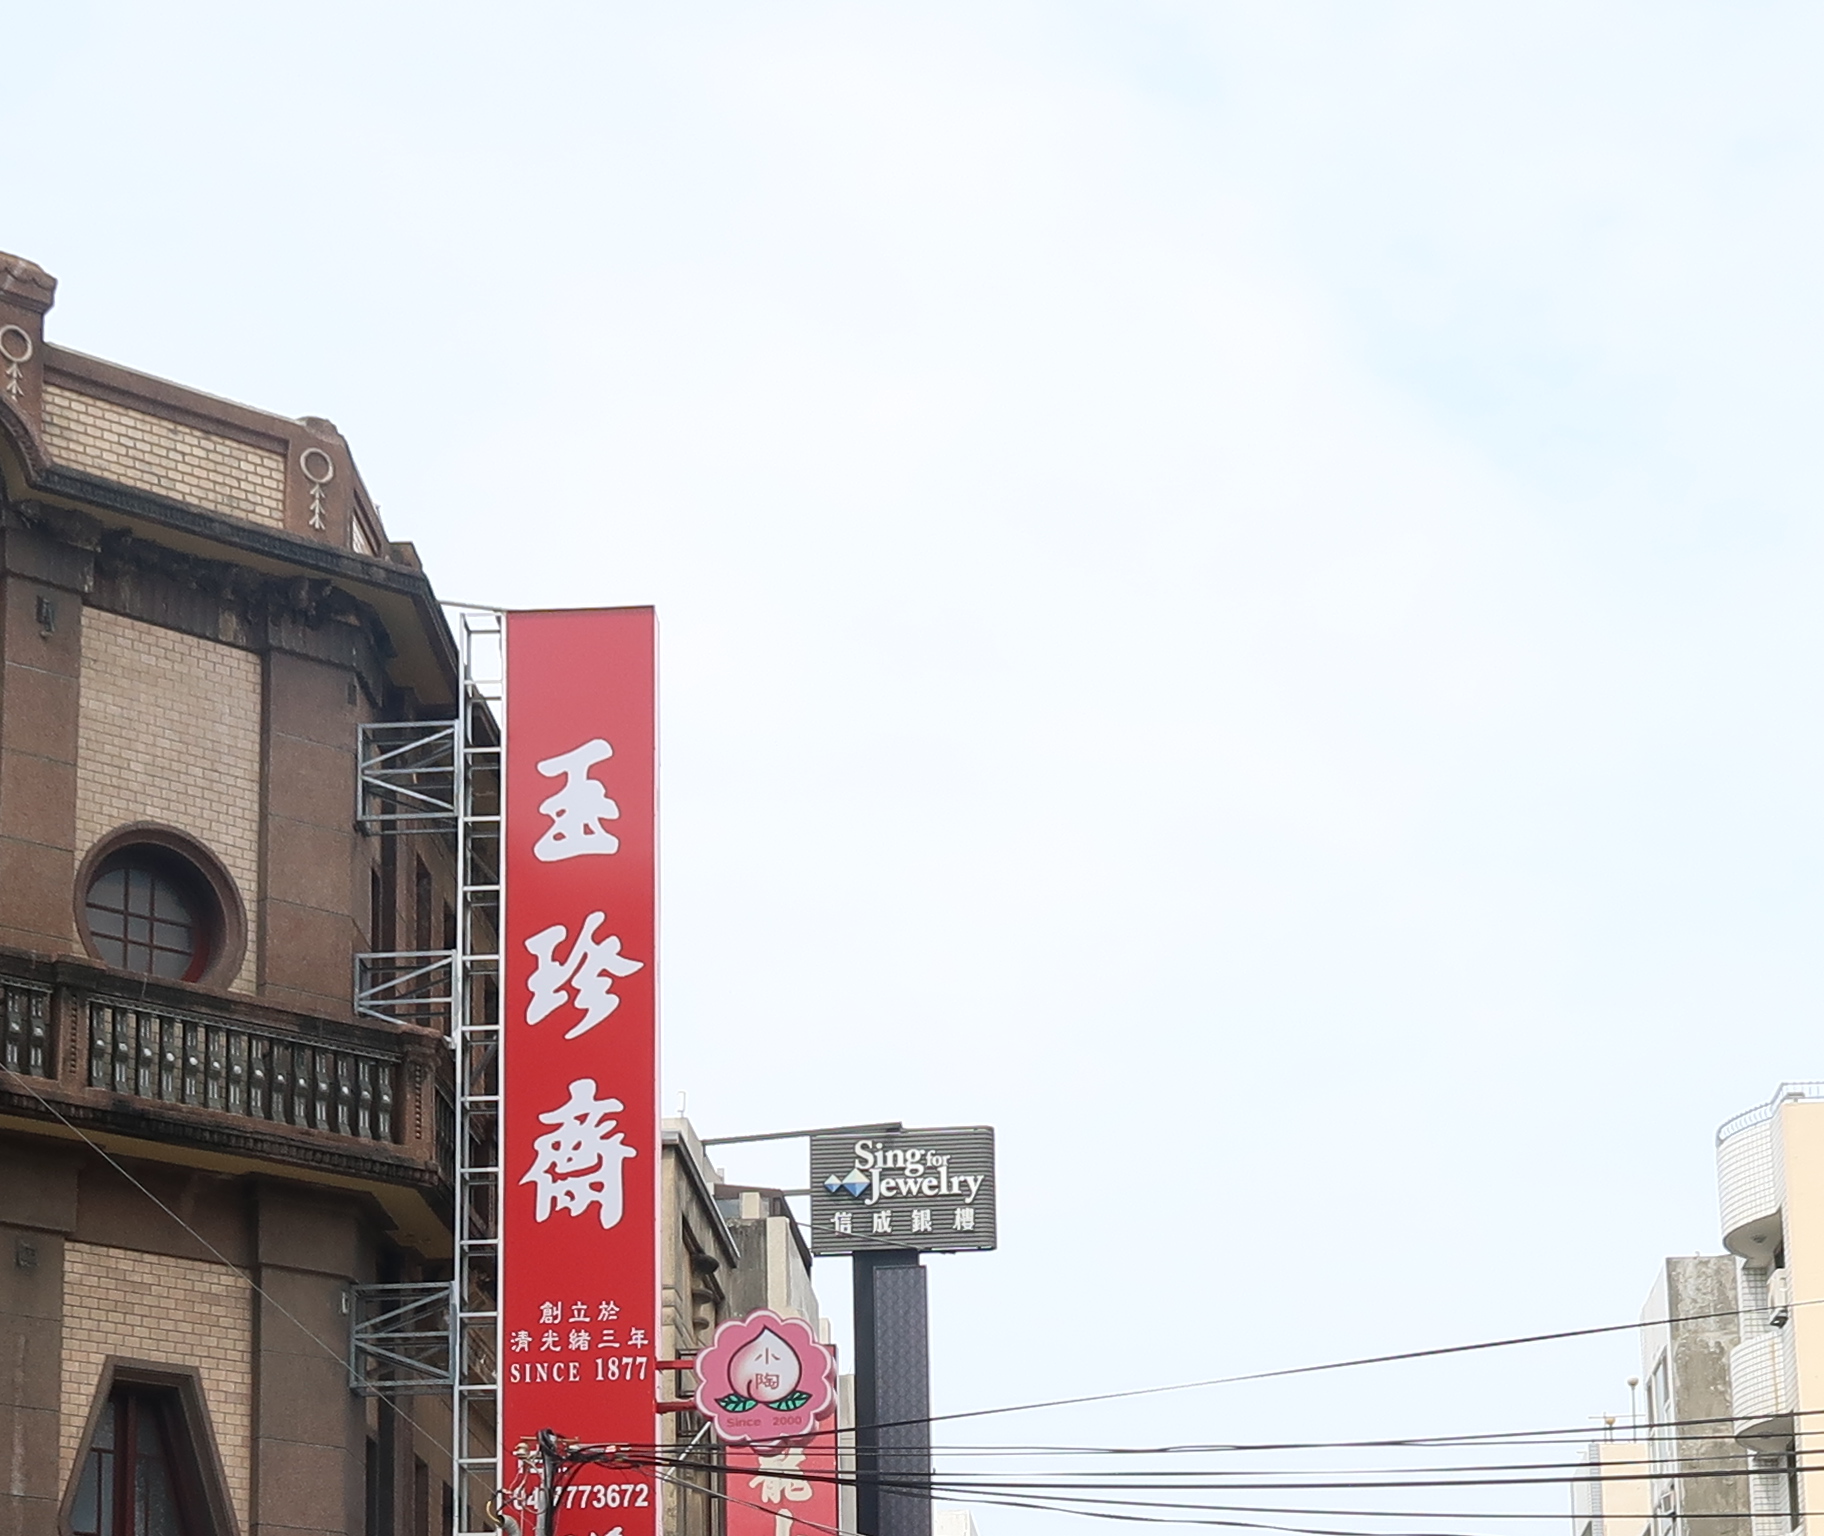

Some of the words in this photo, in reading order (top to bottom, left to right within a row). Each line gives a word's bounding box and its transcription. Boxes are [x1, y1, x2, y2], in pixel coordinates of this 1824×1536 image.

[519, 738, 644, 1229] 玉珍齋
[854, 1140, 925, 1177] Sing
[925, 1150, 951, 1168] for
[864, 1166, 984, 1205] Jewelry
[831, 1208, 975, 1234] 信成銀樓
[539, 1301, 620, 1324] 創立於
[510, 1328, 649, 1351] 清光緒三年
[510, 1362, 581, 1383] SINCE
[594, 1357, 648, 1382] 1877
[726, 1416, 762, 1428] Since
[772, 1415, 803, 1427] 2000
